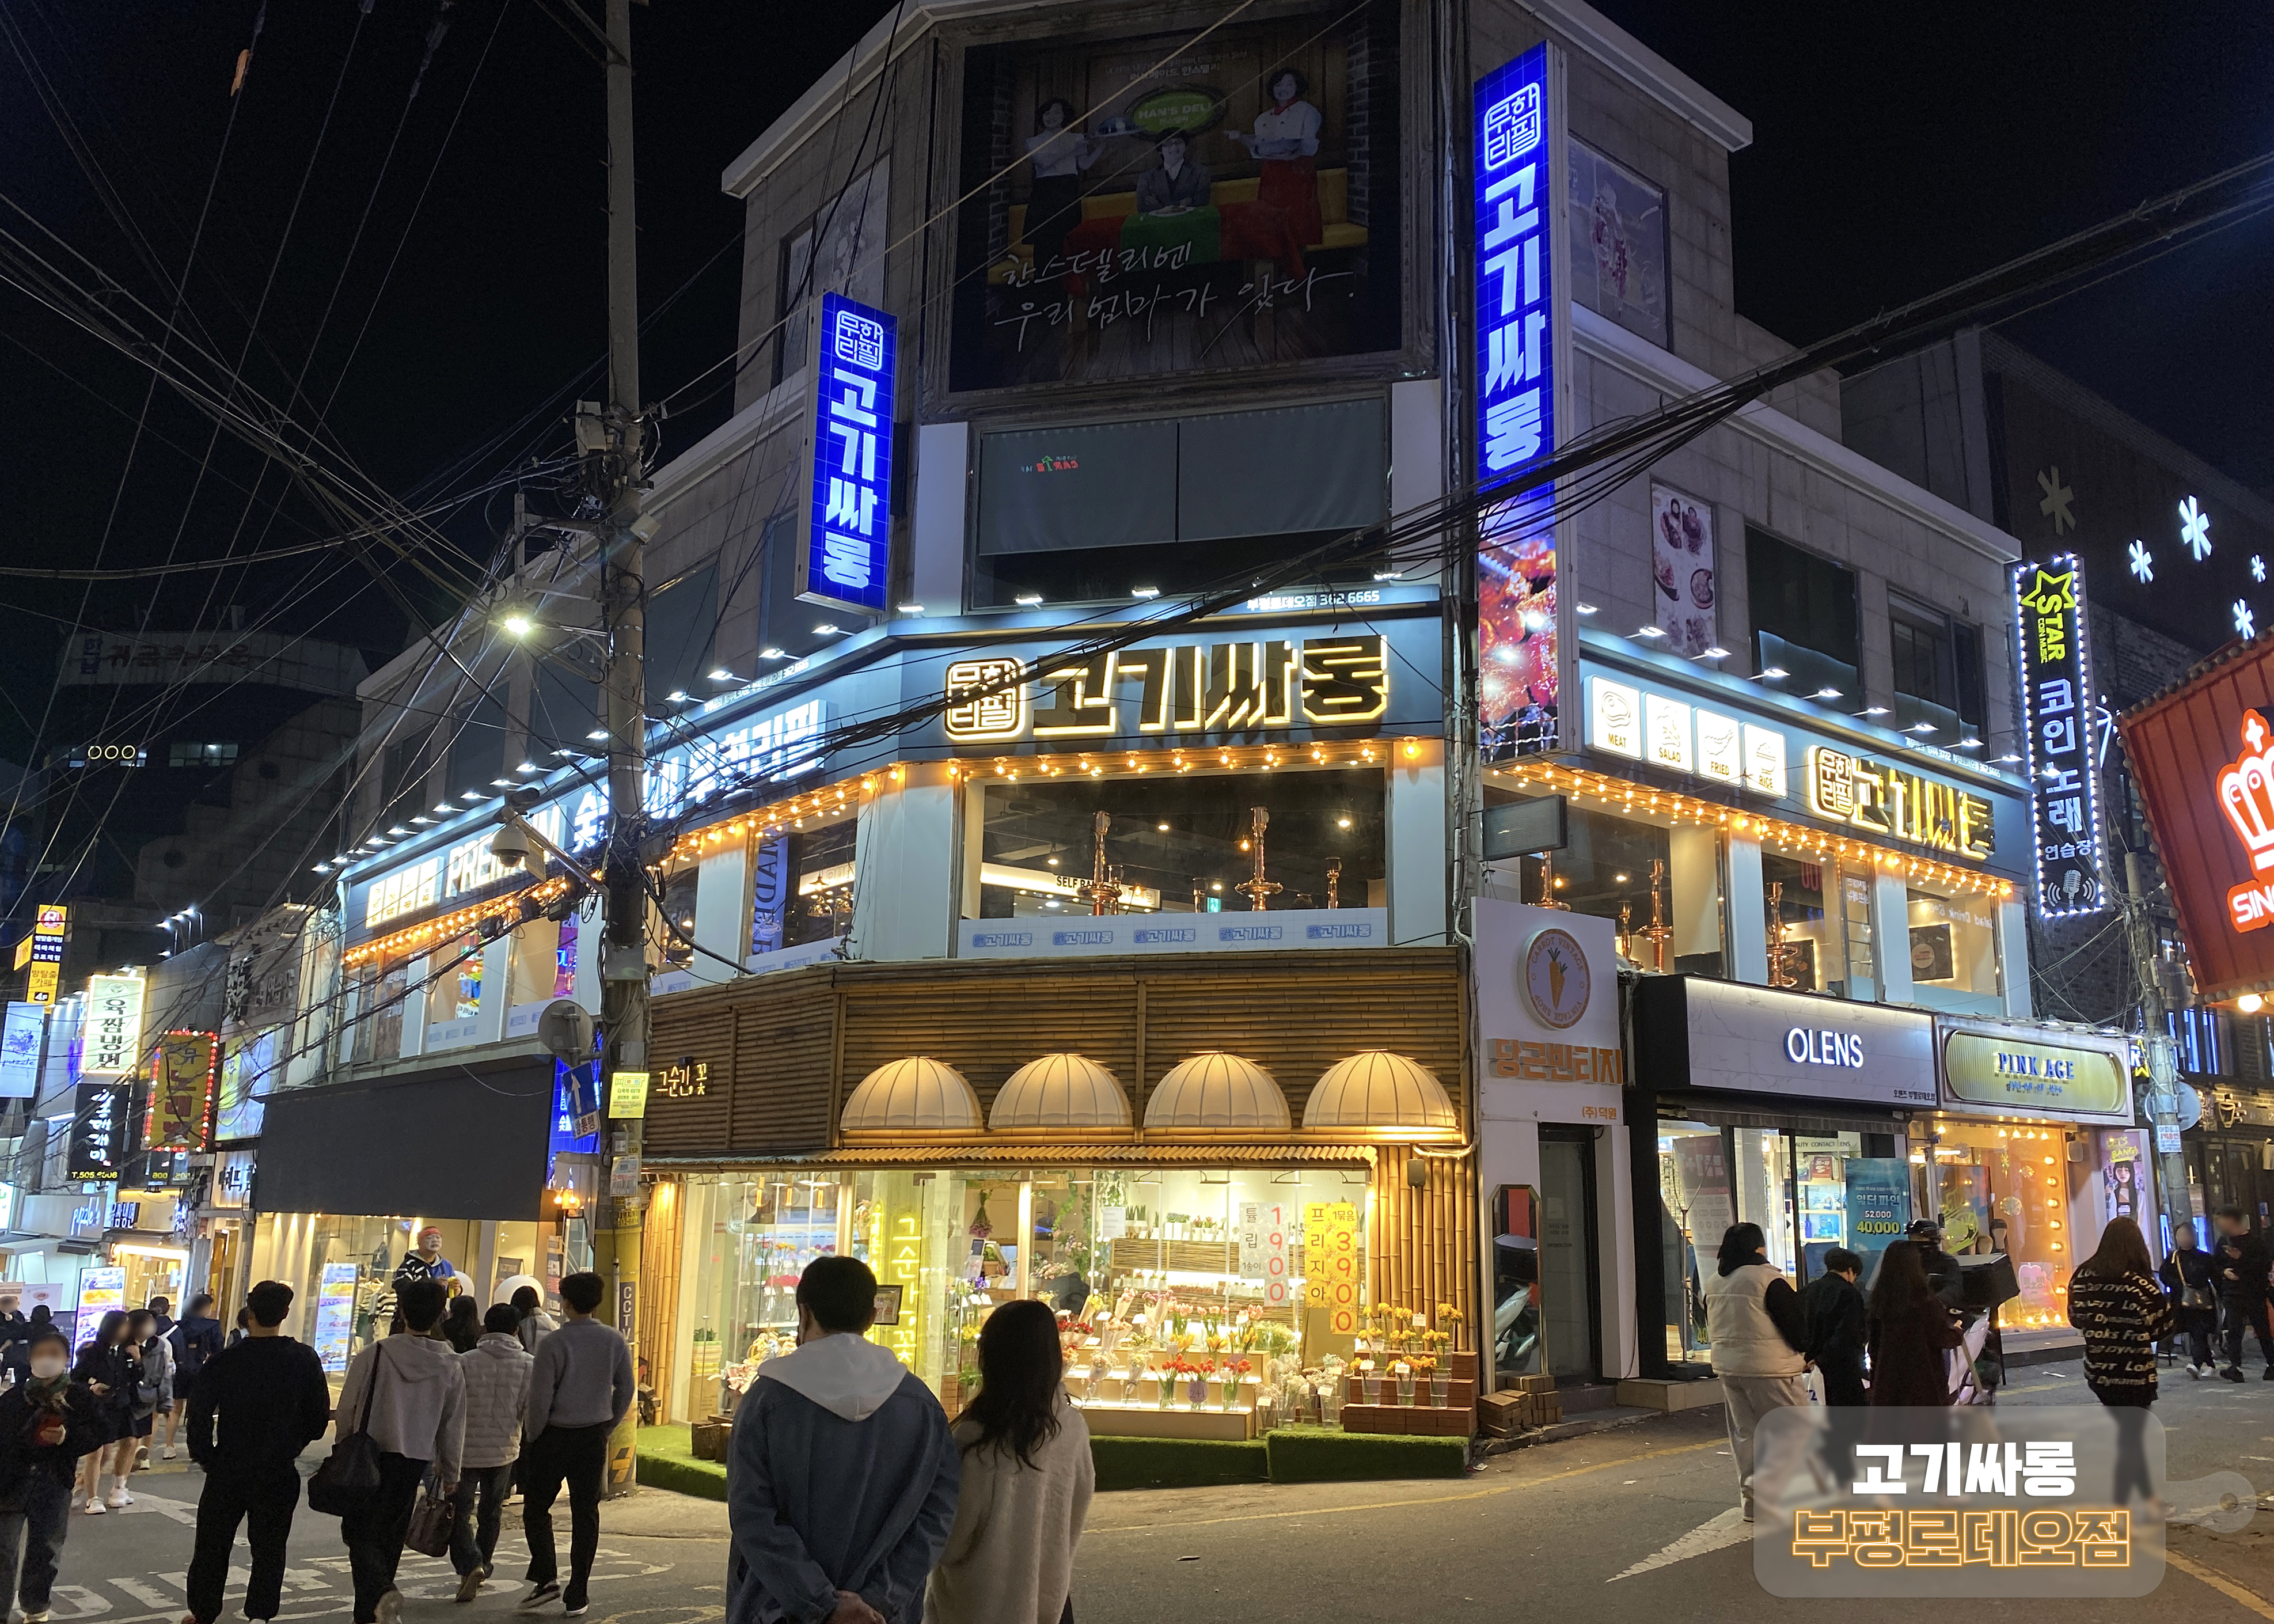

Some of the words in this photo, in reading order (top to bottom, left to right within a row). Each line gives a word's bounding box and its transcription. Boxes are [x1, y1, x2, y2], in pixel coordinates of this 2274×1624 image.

[1138, 107, 1178, 119] HAN'S
[1182, 103, 1211, 115] DELI
[1002, 241, 1191, 287] 한스델리엔
[994, 298, 1073, 352] 우리
[1088, 282, 1218, 342] 엄마가
[1484, 162, 1546, 471] 고기싸롱
[823, 367, 877, 589] 고기싸롱
[1247, 593, 1318, 612] 부평로데오점
[1320, 590, 1380, 606] 362.6665
[2037, 594, 2066, 662] STAR
[2037, 617, 2046, 639] COIN
[2039, 639, 2048, 665] MUSIC
[1033, 635, 1389, 735] 고기싸롱
[1608, 733, 1626, 748] MEAT
[1658, 747, 1681, 763] SALAD
[2038, 678, 2083, 833] 코인노래
[1710, 761, 1729, 776] FRIED
[1759, 775, 1773, 788] RICE
[445, 805, 561, 898] PREM
[2044, 839, 2093, 861] 연습장
[1057, 875, 1078, 889] SELF
[985, 932, 1032, 947] 고기싸롱
[1064, 930, 1113, 945] 고기싸롱
[1146, 928, 1195, 943] 고기싸롱
[1232, 927, 1282, 940] 고기싸롱
[1320, 924, 1371, 938] 고기싸롱
[1532, 936, 1555, 965] CARROT
[1558, 938, 1584, 972] VINTAGE
[32, 970, 57, 978] 방탈출
[35, 978, 52, 986] 카페
[35, 993, 48, 1001] 4F
[1534, 993, 1551, 1017] SHOP
[1554, 1000, 1583, 1022] VINTAGE
[98, 999, 127, 1069] 육쌈냉면
[1786, 1027, 1863, 1068] OLENS
[1491, 1038, 1623, 1084] 당근빈티지
[1999, 1053, 2038, 1076] PINK
[2046, 1059, 2074, 1079] AGE
[696, 1063, 707, 1095] 꽃
[1582, 1106, 1617, 1120] (주)덕원
[1856, 1194, 1900, 1205] 워터파인
[1332, 1210, 1356, 1222] 1묶음
[1245, 1208, 1257, 1249] 튤립
[1857, 1220, 1900, 1235] 40,000
[1269, 1206, 1284, 1302] 1900
[1311, 1208, 1327, 1300] 프리지아
[1243, 1261, 1262, 1272] 1송이
[1335, 1231, 1352, 1331] 3900
[622, 1285, 632, 1342] CCTV
[1190, 1388, 1205, 1399] 2+1
